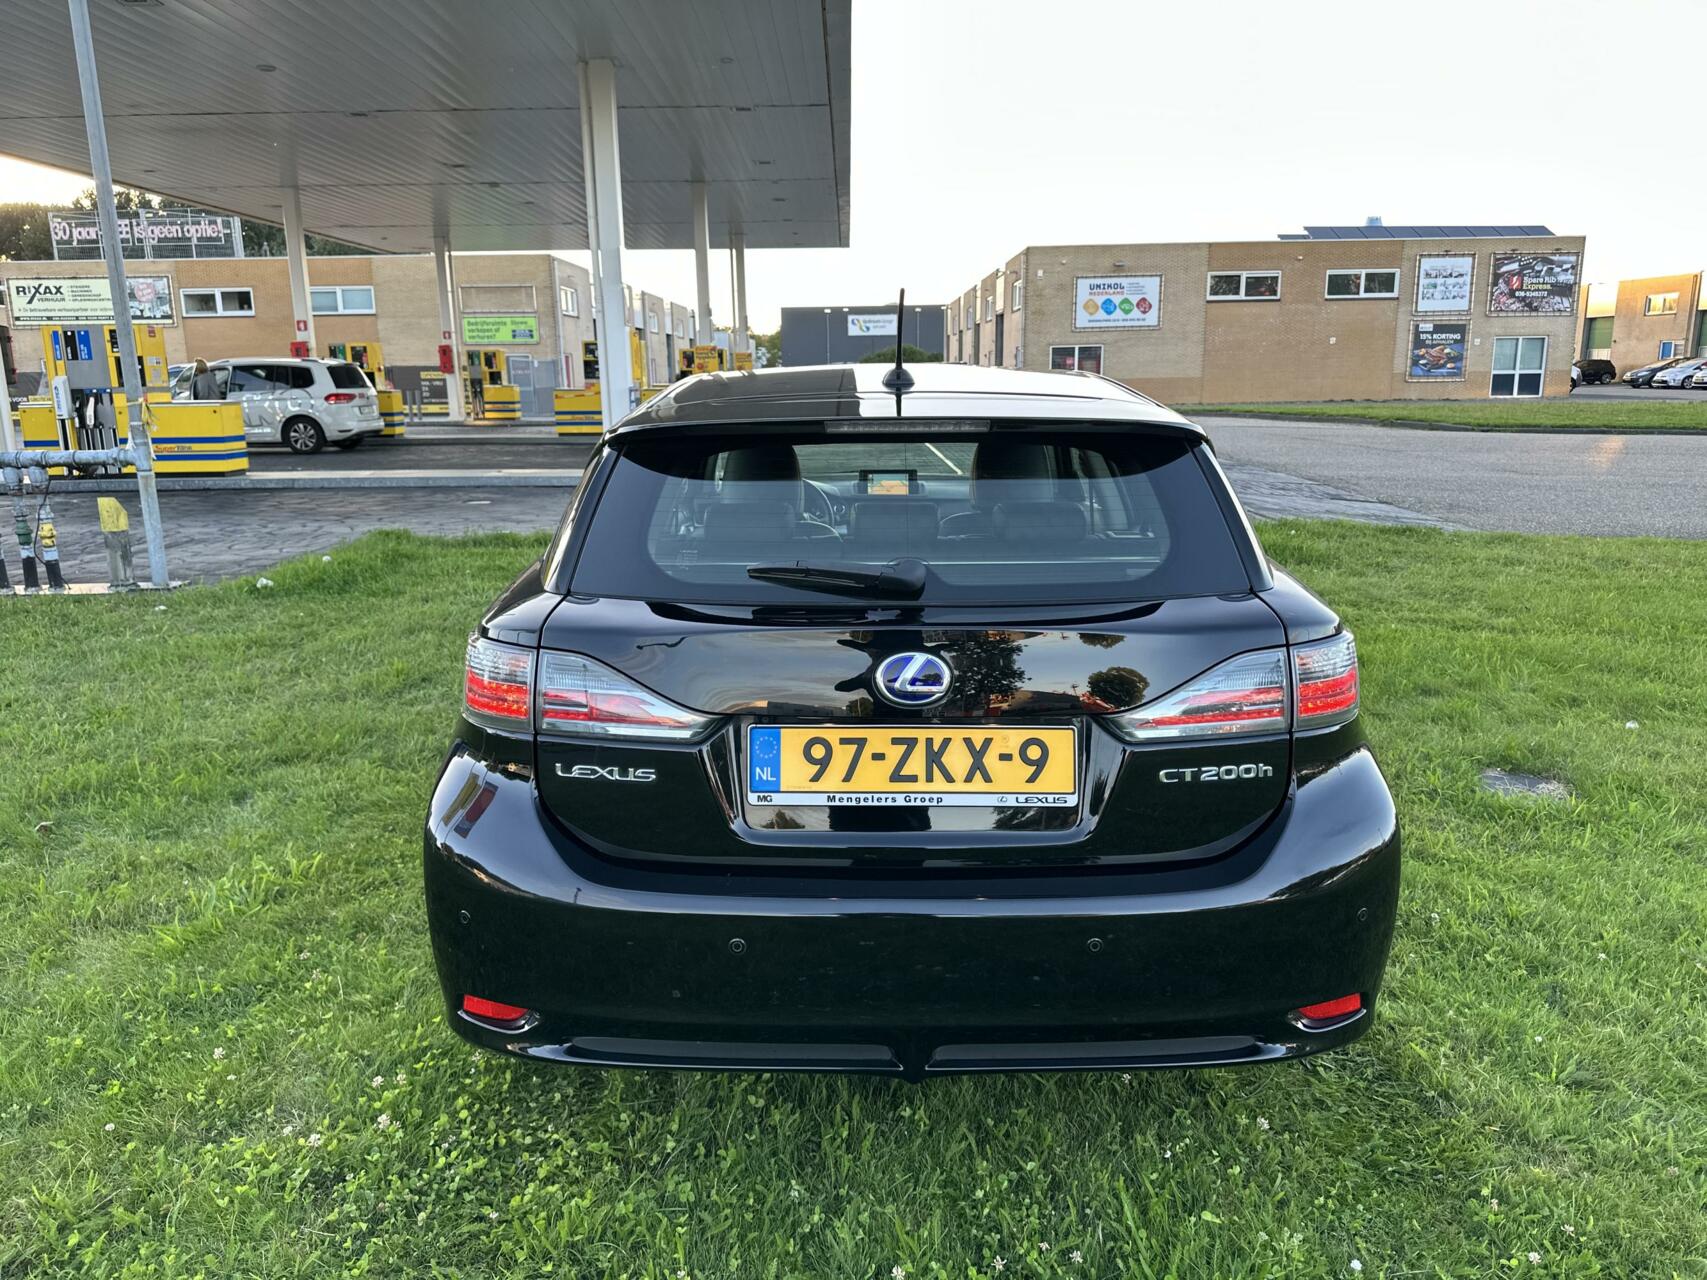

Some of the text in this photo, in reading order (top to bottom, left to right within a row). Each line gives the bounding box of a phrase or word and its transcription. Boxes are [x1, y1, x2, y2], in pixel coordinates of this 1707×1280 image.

[52, 222, 70, 240] 30
[71, 222, 100, 246] jaar
[149, 223, 182, 243] geen
[1089, 282, 1125, 291] UNIKOL
[802, 736, 1050, 784] 97-ZKX-9
[555, 763, 656, 782] LEXUS
[755, 767, 777, 782] NL
[757, 794, 773, 803] MG
[826, 794, 944, 805] Mengelers Groep
[1015, 796, 1068, 805] LEXUS
